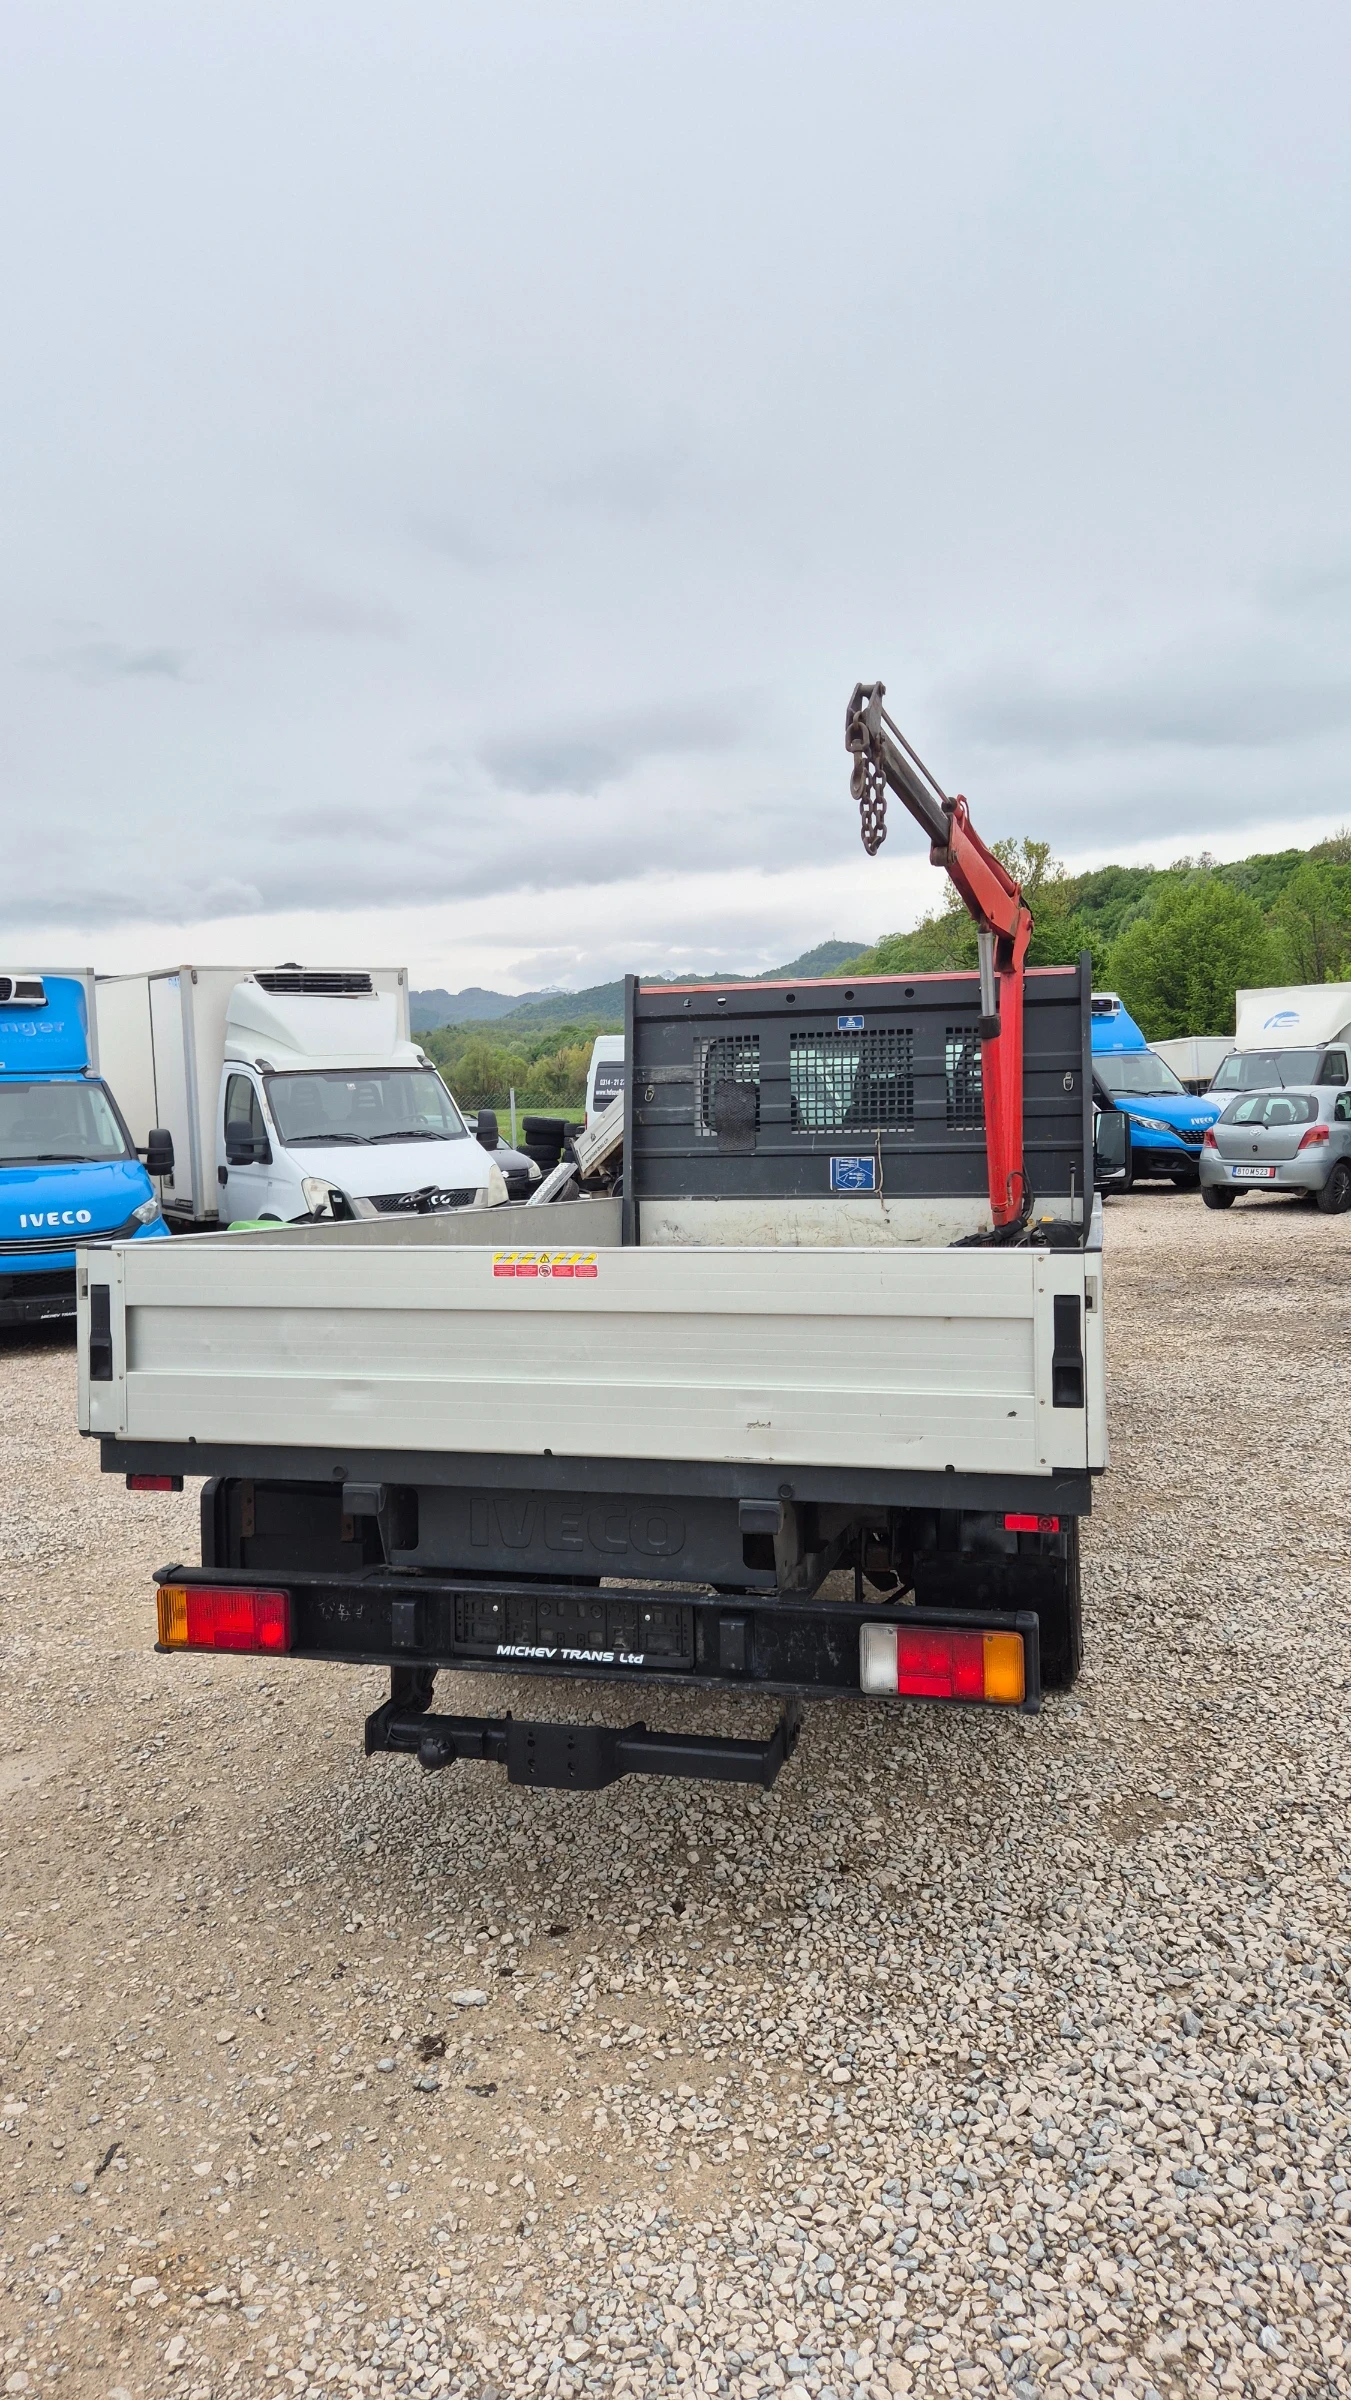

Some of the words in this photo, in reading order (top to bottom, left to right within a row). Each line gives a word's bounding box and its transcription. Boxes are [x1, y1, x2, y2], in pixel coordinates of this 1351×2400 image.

[1190, 1116, 1214, 1126] IVECO
[20, 1209, 92, 1229] IVECO
[469, 1497, 687, 1557] IVECO
[496, 1644, 558, 1659] MICHEV
[560, 1648, 615, 1663] TRANS
[618, 1652, 645, 1665] Ltd
